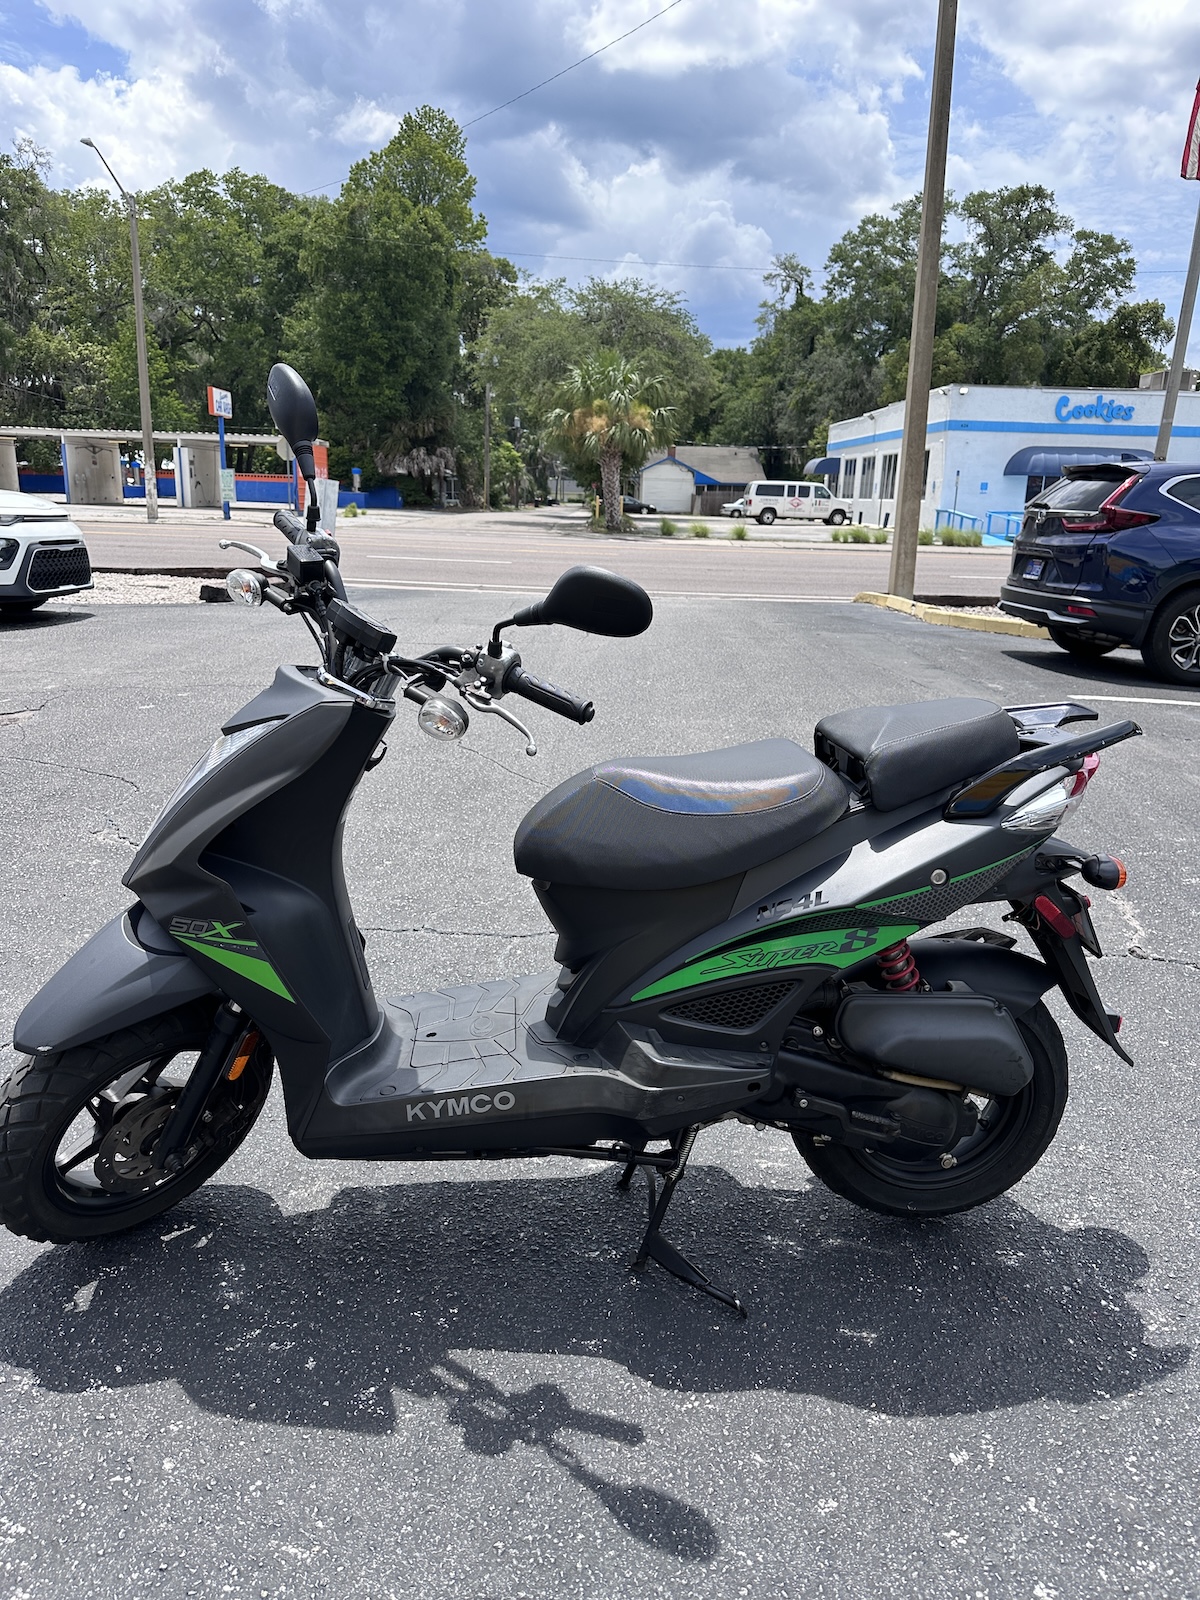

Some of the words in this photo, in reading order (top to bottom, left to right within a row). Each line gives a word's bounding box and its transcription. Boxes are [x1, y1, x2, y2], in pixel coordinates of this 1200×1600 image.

[1055, 395, 1135, 423] Cookies
[840, 927, 880, 954] 8
[406, 1090, 516, 1122] KYMCO
